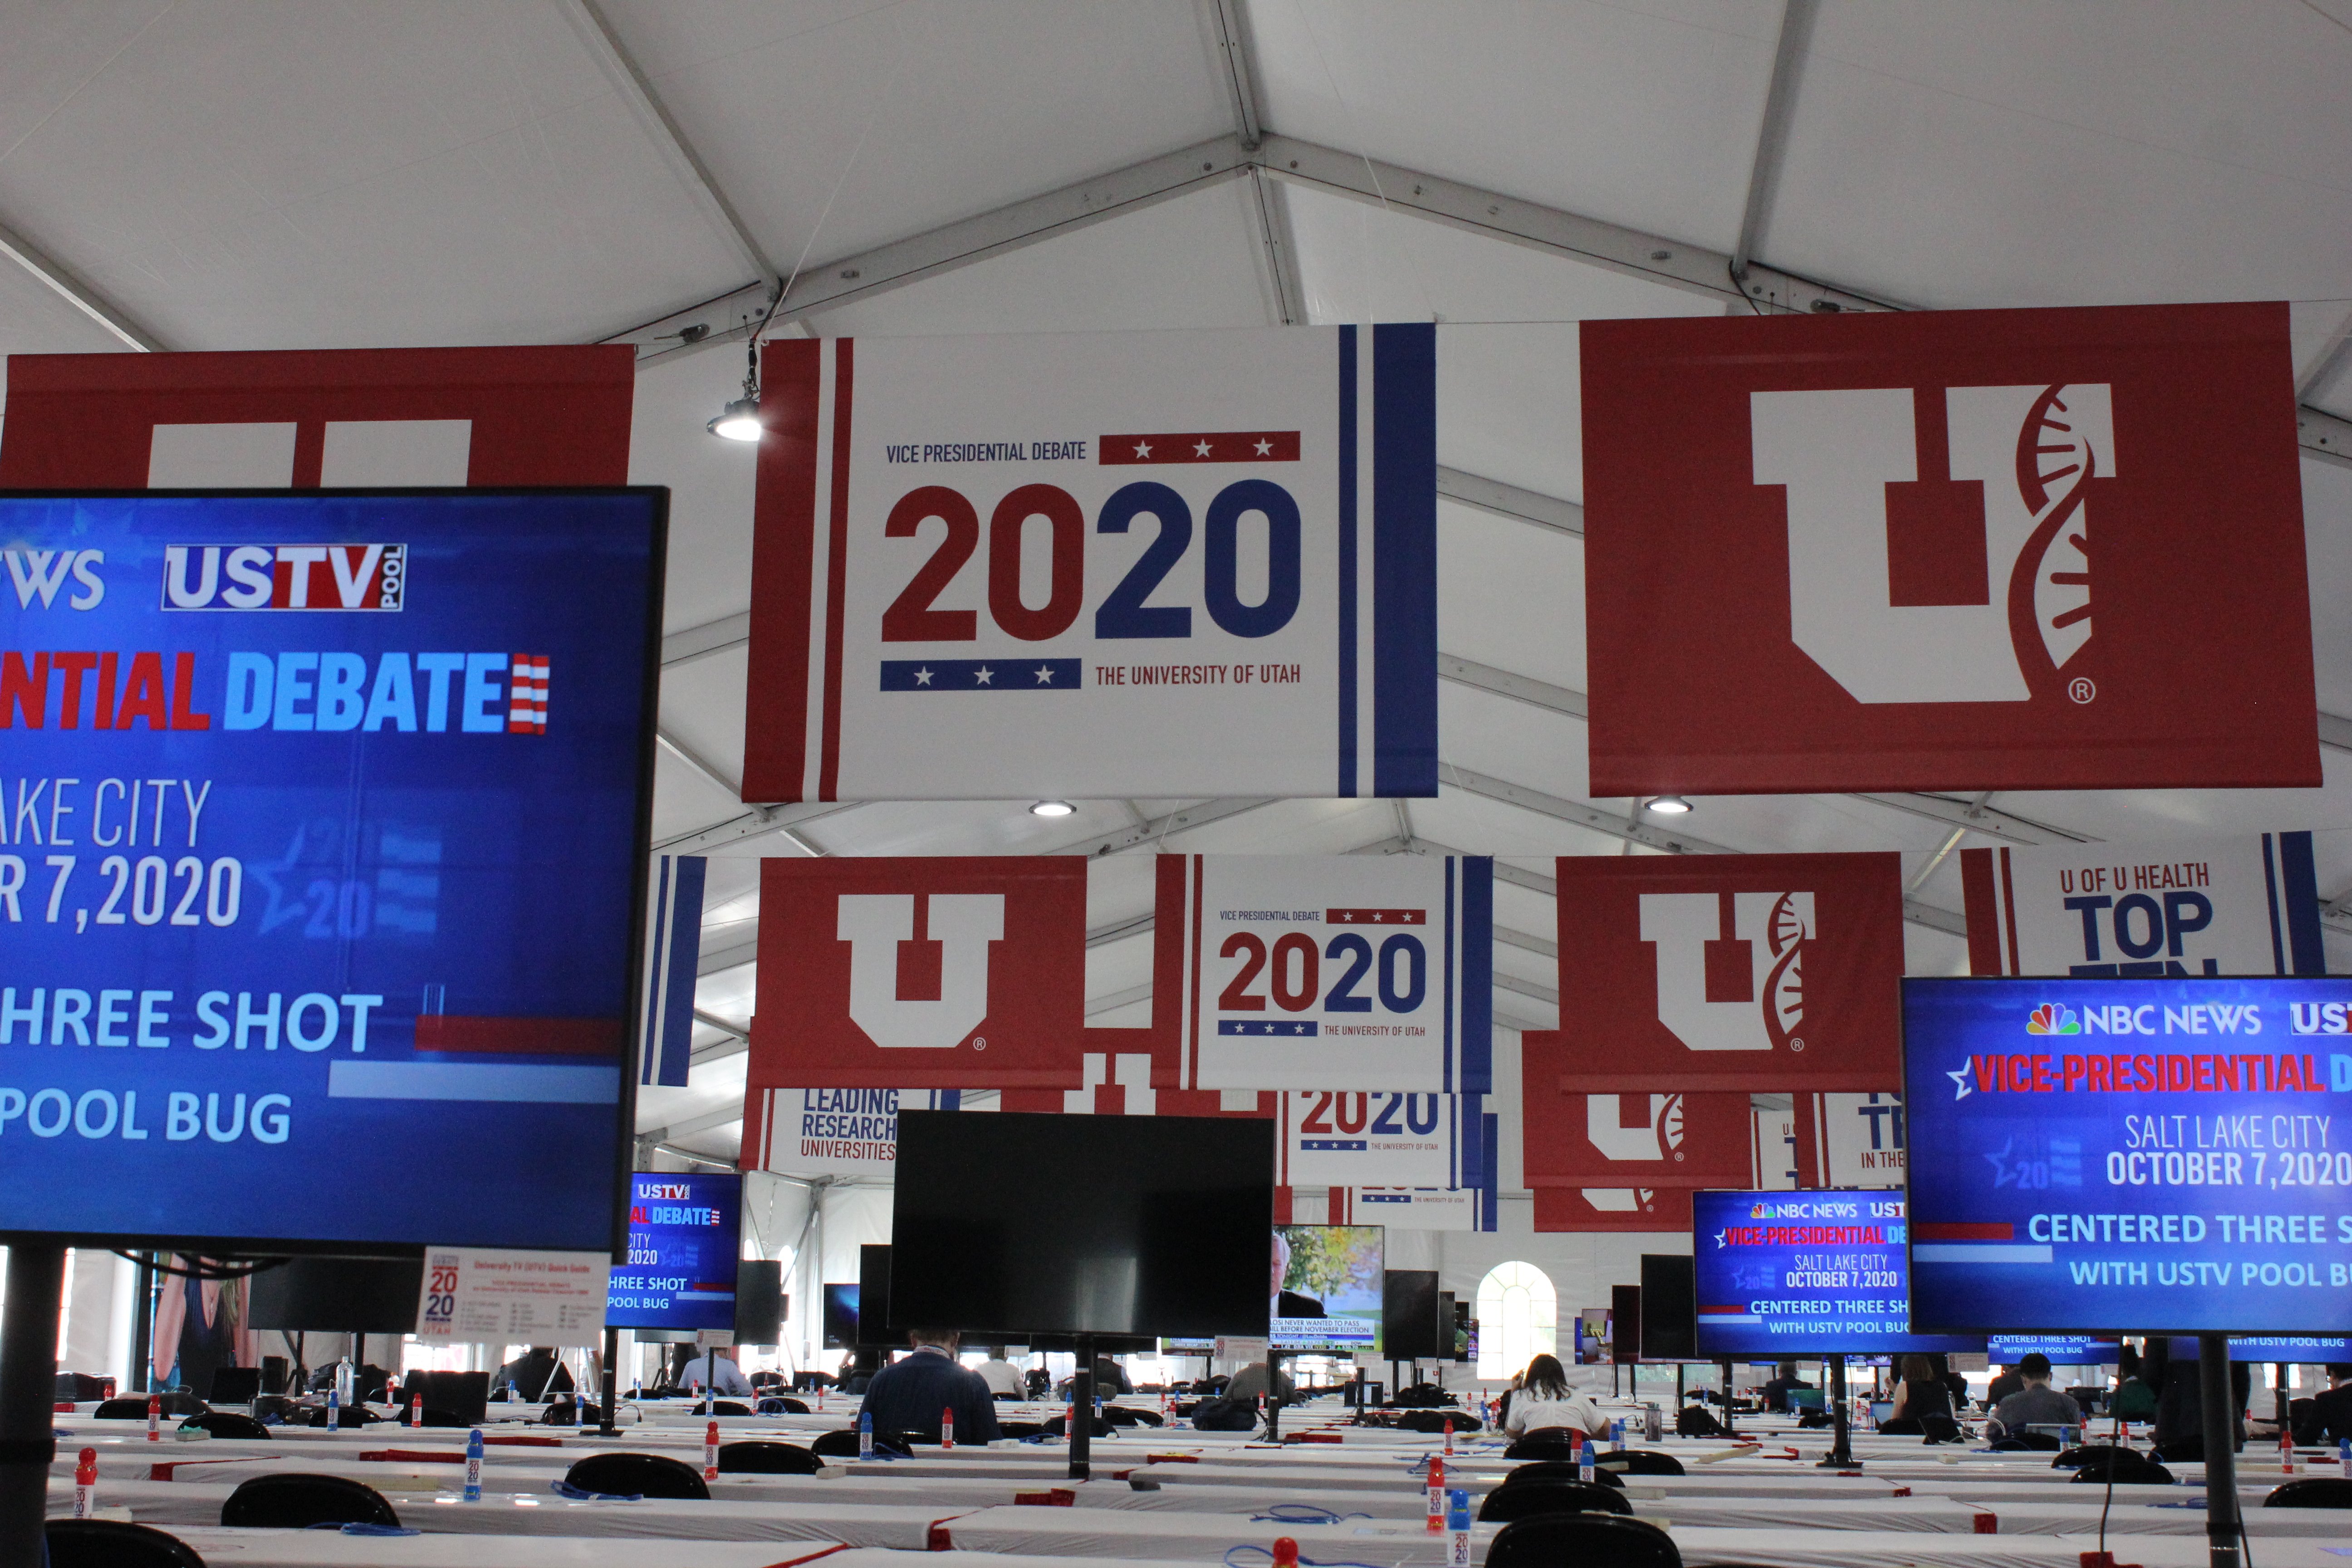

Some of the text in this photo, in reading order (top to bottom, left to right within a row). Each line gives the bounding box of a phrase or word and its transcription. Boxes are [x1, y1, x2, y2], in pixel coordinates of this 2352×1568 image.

[887, 441, 1087, 463] VICE PRESIDENTIAL DEBATE
[882, 479, 1301, 642] 2020
[0, 546, 384, 611] WS USTV
[381, 545, 402, 608] POOL
[1096, 664, 1301, 686] THE UNIVERSITY OF UTAH
[224, 652, 508, 733] DEBATE
[0, 778, 212, 848] KE CITY
[2060, 862, 2210, 893] U OF U HEALTH
[1220, 911, 1320, 921] VICE PRESIDENTIAL DEBATE
[2064, 891, 2214, 961] TOP
[837, 893, 1005, 1048] U
[1219, 931, 1426, 1014] 2020
[193, 990, 383, 1053] SHOT
[1324, 1025, 1425, 1036] THE UNIVERSITY OF UTAH
[2083, 1004, 2156, 1034] NBC
[2165, 1004, 2262, 1035] NEWS
[1972, 1054, 2326, 1092] VICE-PRESIDENTIAL
[804, 1089, 899, 1115] LEADING
[1301, 1091, 1438, 1135] 2020
[166, 1091, 292, 1144] BUG
[802, 1114, 898, 1141] RESEARCH
[2125, 1115, 2330, 1149] SALT LAKE CITY
[801, 1140, 896, 1161] UNIVERSITIES
[1861, 1152, 1903, 1168] IN THE
[2106, 1151, 2243, 1186] OCTOBER
[638, 1184, 686, 1199] USTV
[652, 1207, 712, 1225] DEBATE
[1777, 1204, 1809, 1218] NBC
[1813, 1203, 1857, 1218] NEWS
[1725, 1226, 1886, 1245] VICE-PRESIDENTIAL
[2029, 1214, 2207, 1243] CENTERED
[2215, 1215, 2327, 1243] THREE
[1795, 1254, 1887, 1270] SALT LAKE CITY
[430, 1271, 458, 1293] 20
[648, 1277, 687, 1290] SHOT
[1786, 1271, 1848, 1287] OCTOBER
[2069, 1261, 2148, 1285] WITH
[2157, 1262, 2232, 1286] USTV
[2241, 1263, 2322, 1287] POOL
[426, 1294, 455, 1315] 20
[607, 1297, 669, 1309] POOL BUG
[1750, 1300, 1831, 1314] CENTERED
[1835, 1300, 1884, 1313] THREE
[1769, 1322, 1805, 1333] WITH
[1808, 1322, 1842, 1333] USTV
[1846, 1322, 1882, 1333] POOL
[2259, 1338, 2286, 1346] USTV
[2290, 1338, 2319, 1347] POOL
[2322, 1338, 2345, 1347] BUG
[468, 1471, 478, 1480] 20
[469, 1462, 479, 1471] 20
[1430, 1502, 1441, 1510] 20
[1431, 1492, 1441, 1501] 20
[1455, 1537, 1468, 1548] 20
[1455, 1548, 1468, 1560] 20
